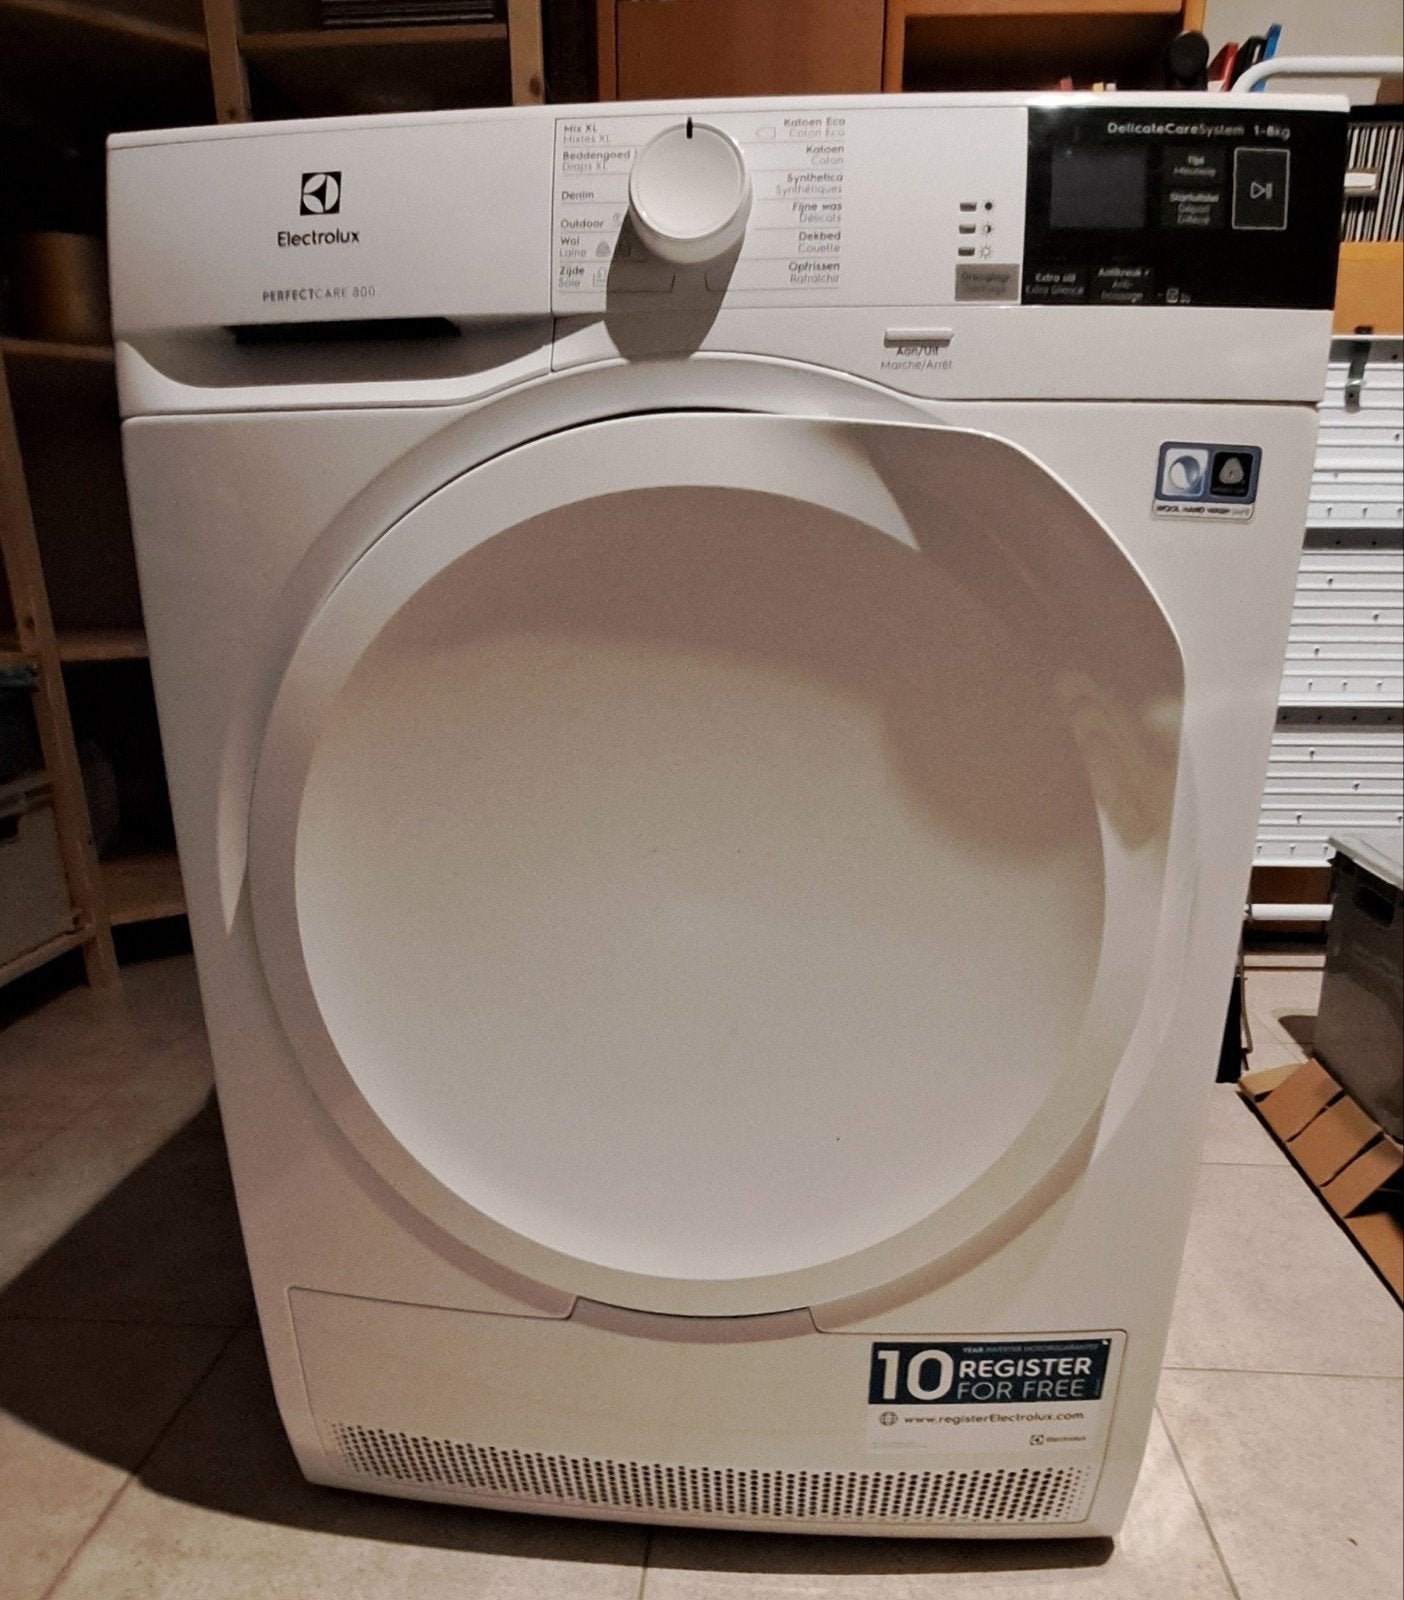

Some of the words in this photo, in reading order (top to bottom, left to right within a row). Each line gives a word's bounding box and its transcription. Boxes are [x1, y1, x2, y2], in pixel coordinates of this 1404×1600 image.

[784, 117, 822, 127] Katoen
[826, 117, 846, 126] Eco
[564, 124, 582, 133] Mix
[585, 124, 598, 132] XL
[825, 127, 845, 136] Eco
[1107, 122, 1245, 137] DelicateCareSystem
[805, 145, 845, 154] Katoen
[563, 150, 631, 161] Beddengoed
[811, 156, 844, 165] Coton
[787, 173, 844, 184] Synthetica
[561, 190, 595, 200] Denim
[822, 203, 843, 211] was
[560, 219, 604, 229] Outdoor
[277, 228, 360, 247] Electrolux
[560, 235, 581, 246] Wol
[798, 230, 842, 241] Dekbed
[559, 248, 588, 258] Laine
[559, 265, 586, 278] Zijde
[788, 261, 841, 273] Opfrissen
[558, 277, 582, 288] Soie
[262, 287, 348, 302] PERFECTCARE
[352, 286, 376, 298] 800
[880, 358, 953, 371] Marche/Arrêt
[959, 1357, 1093, 1379] REGISTER
[877, 1350, 954, 1401] 10
[957, 1382, 1013, 1400] FOR
[1022, 1379, 1086, 1400] FREE
[904, 1411, 1085, 1427] www.registerElectrolux.com
